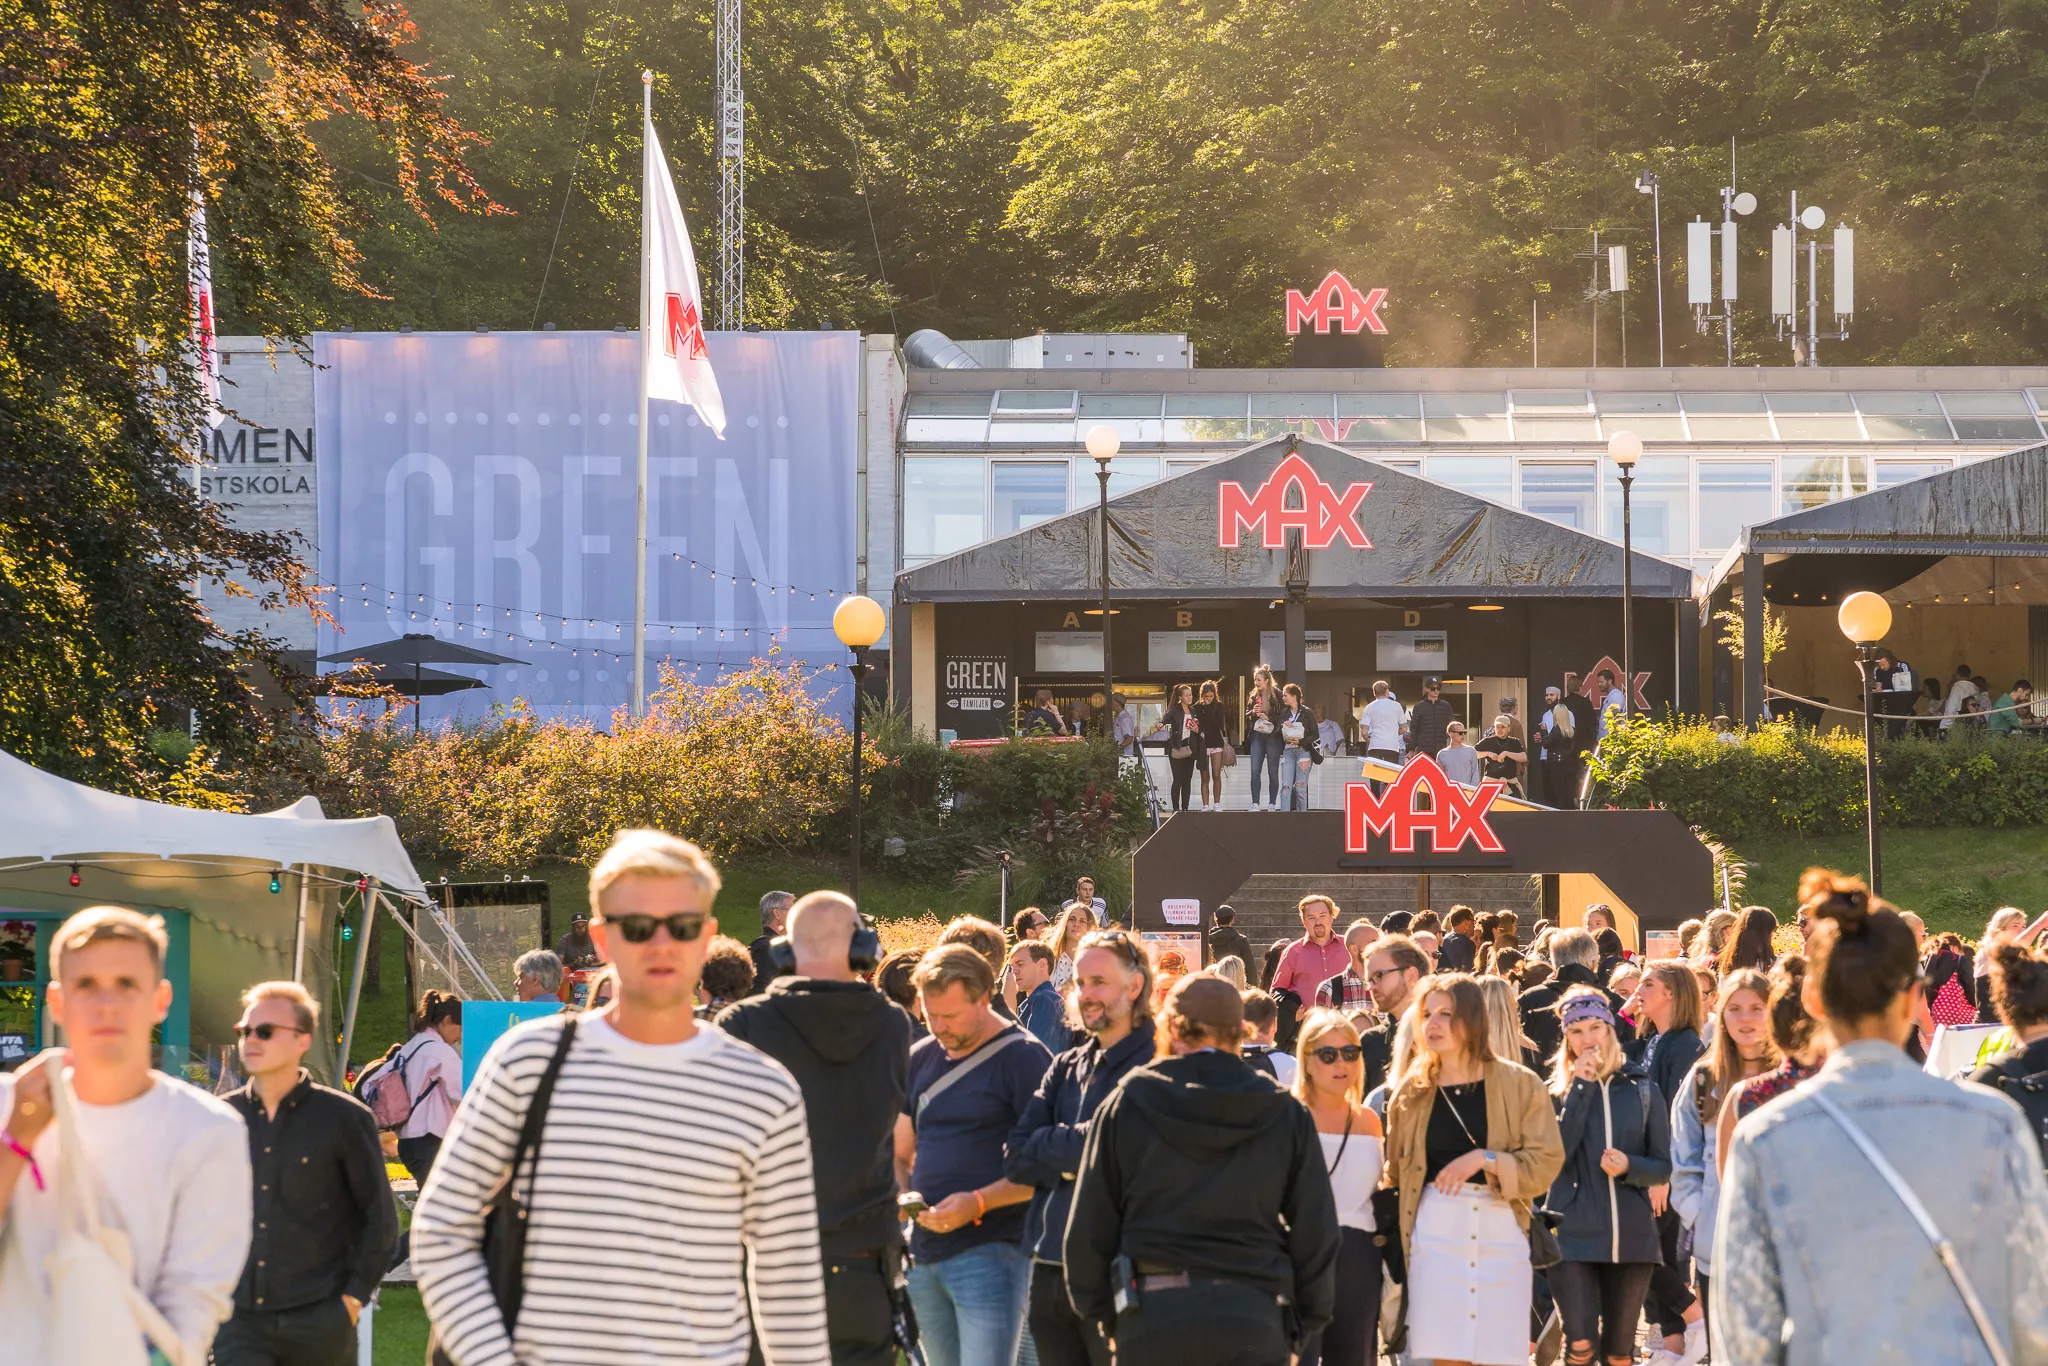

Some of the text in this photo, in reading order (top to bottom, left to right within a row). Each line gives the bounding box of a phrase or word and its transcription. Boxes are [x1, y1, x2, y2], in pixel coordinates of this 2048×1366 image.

[1286, 269, 1389, 335] MAX
[181, 476, 311, 494] STSKOLA
[1218, 452, 1375, 550] MAX
[384, 452, 789, 642] GREEN
[1062, 611, 1081, 628] A
[1176, 610, 1193, 627] B
[1404, 610, 1420, 627] D
[946, 661, 1006, 690] GREEN
[963, 699, 989, 708] FAMILJEN
[1345, 751, 1507, 853] MAX
